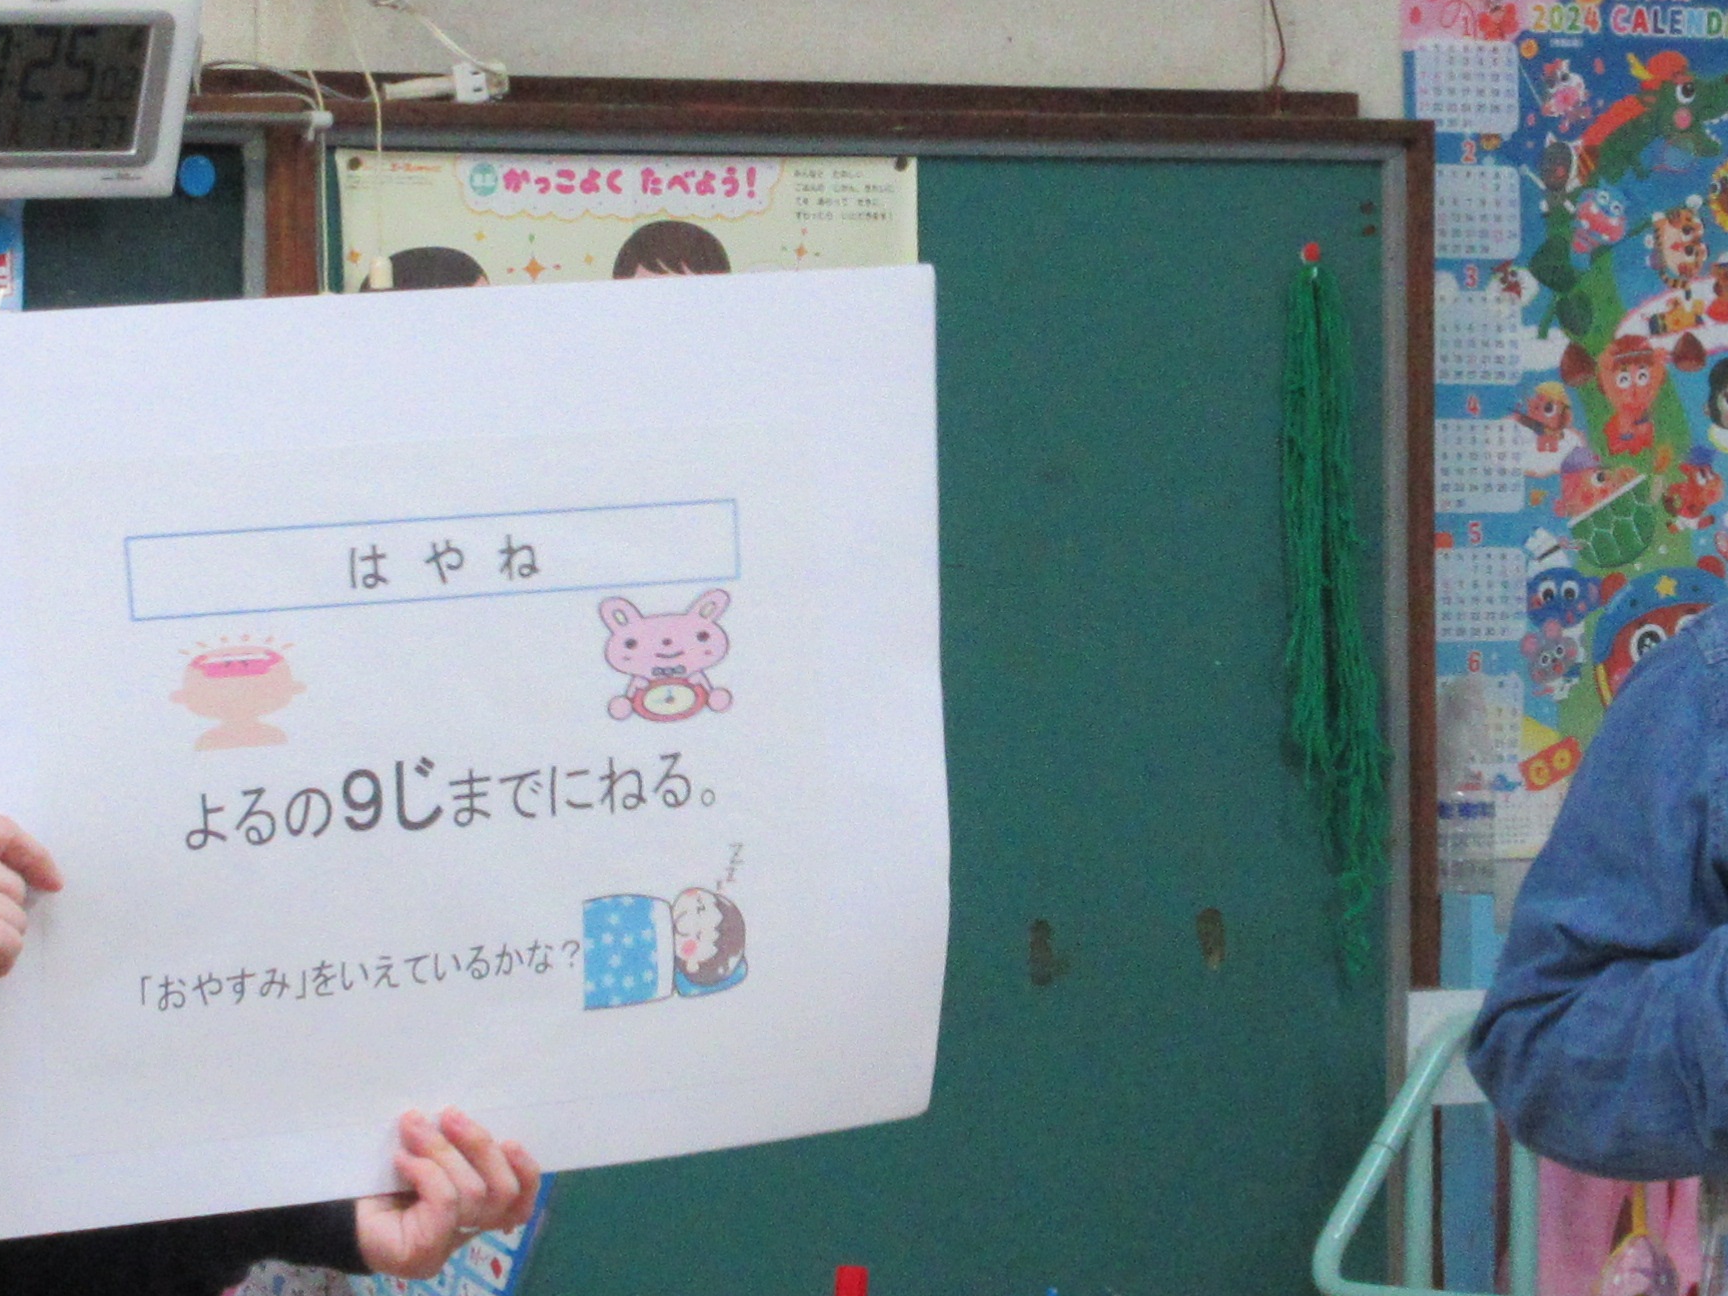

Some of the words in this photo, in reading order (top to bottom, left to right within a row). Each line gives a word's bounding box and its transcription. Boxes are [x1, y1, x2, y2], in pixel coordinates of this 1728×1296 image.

[1531, 3, 1601, 33] 2024
[501, 166, 624, 196] かっこよく
[348, 536, 540, 590] はやね
[183, 752, 718, 852] よるの9じまでにねる。
[139, 938, 583, 1013] 「おやすみ」をいえているかな？
